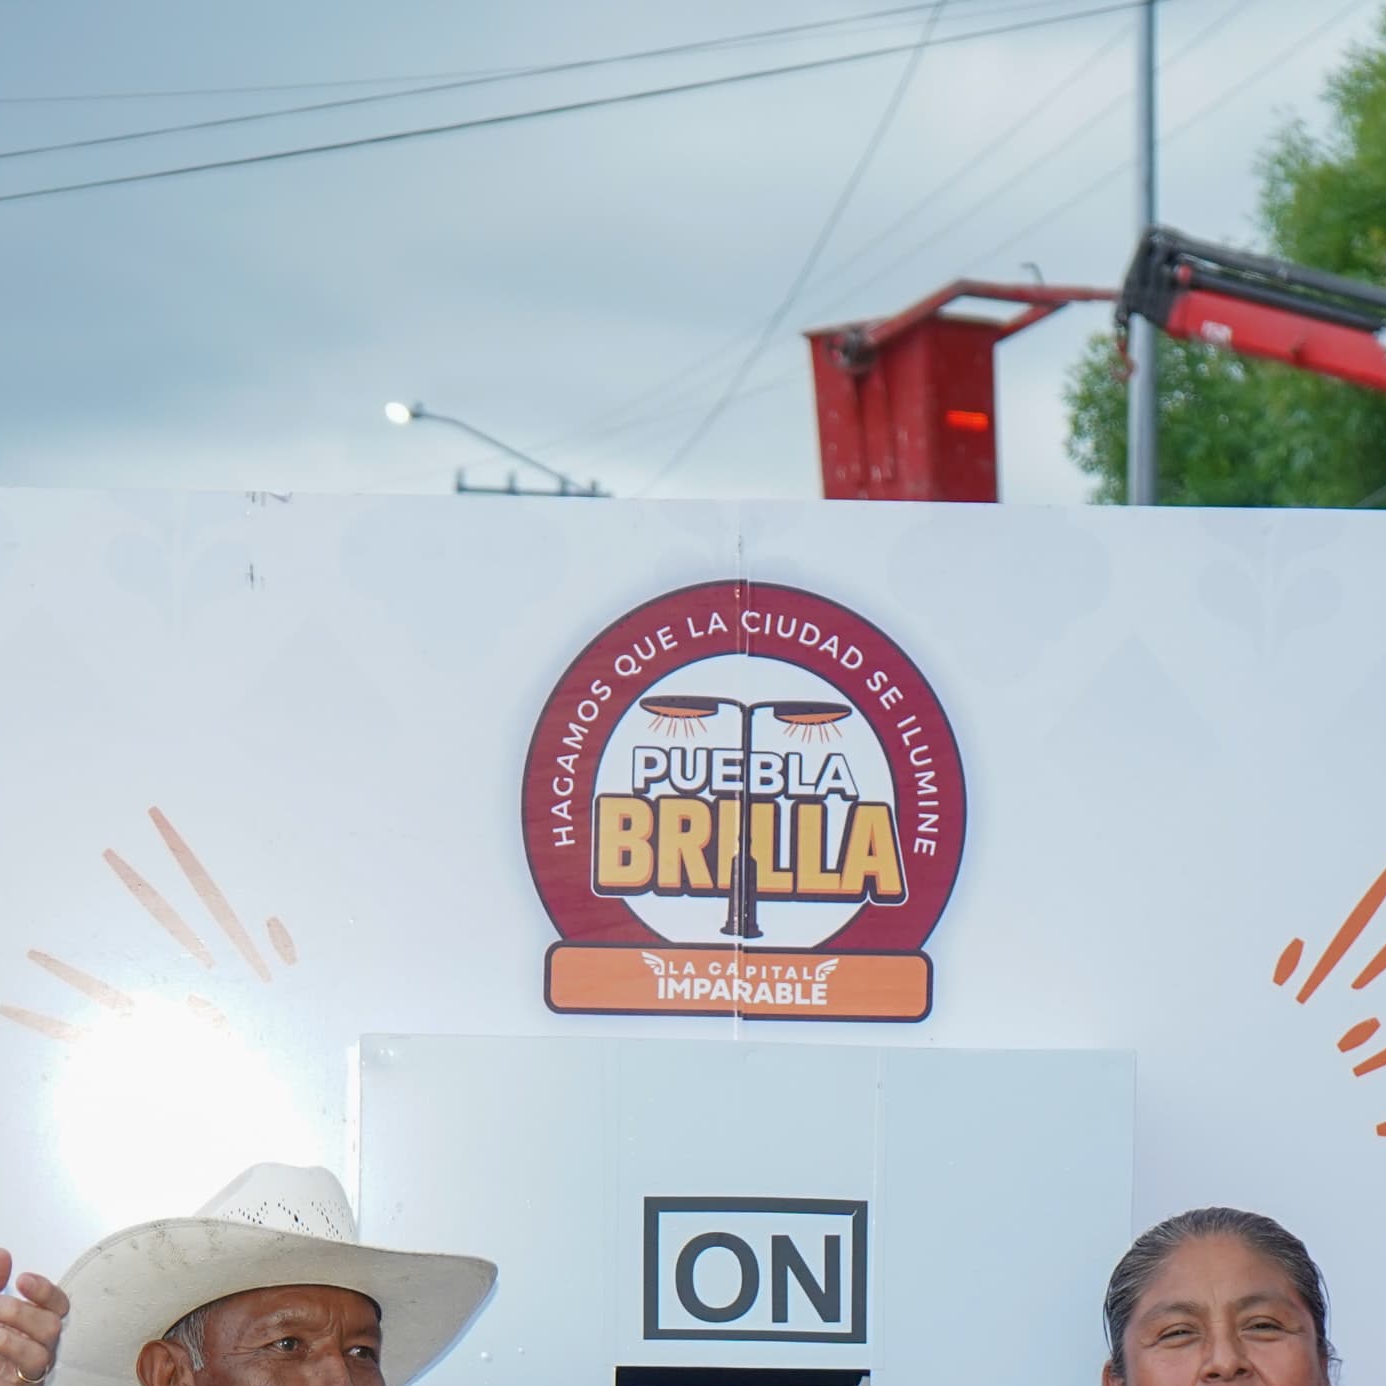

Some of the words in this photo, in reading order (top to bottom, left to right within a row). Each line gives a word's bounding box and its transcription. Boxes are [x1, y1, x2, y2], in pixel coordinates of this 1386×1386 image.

[550, 679, 612, 847] HAGAMOS
[614, 626, 679, 677] QUE
[686, 612, 729, 638] LA
[740, 610, 864, 670] CIUDAD
[865, 671, 904, 711] SE
[896, 714, 940, 857] ILUMINE
[632, 746, 859, 798] PUEBLA
[597, 796, 903, 896] BRILLA
[657, 977, 828, 1006] IMPARABLE
[668, 961, 696, 975] LA
[708, 961, 814, 981] CAPITAL
[674, 1231, 841, 1324] ON
